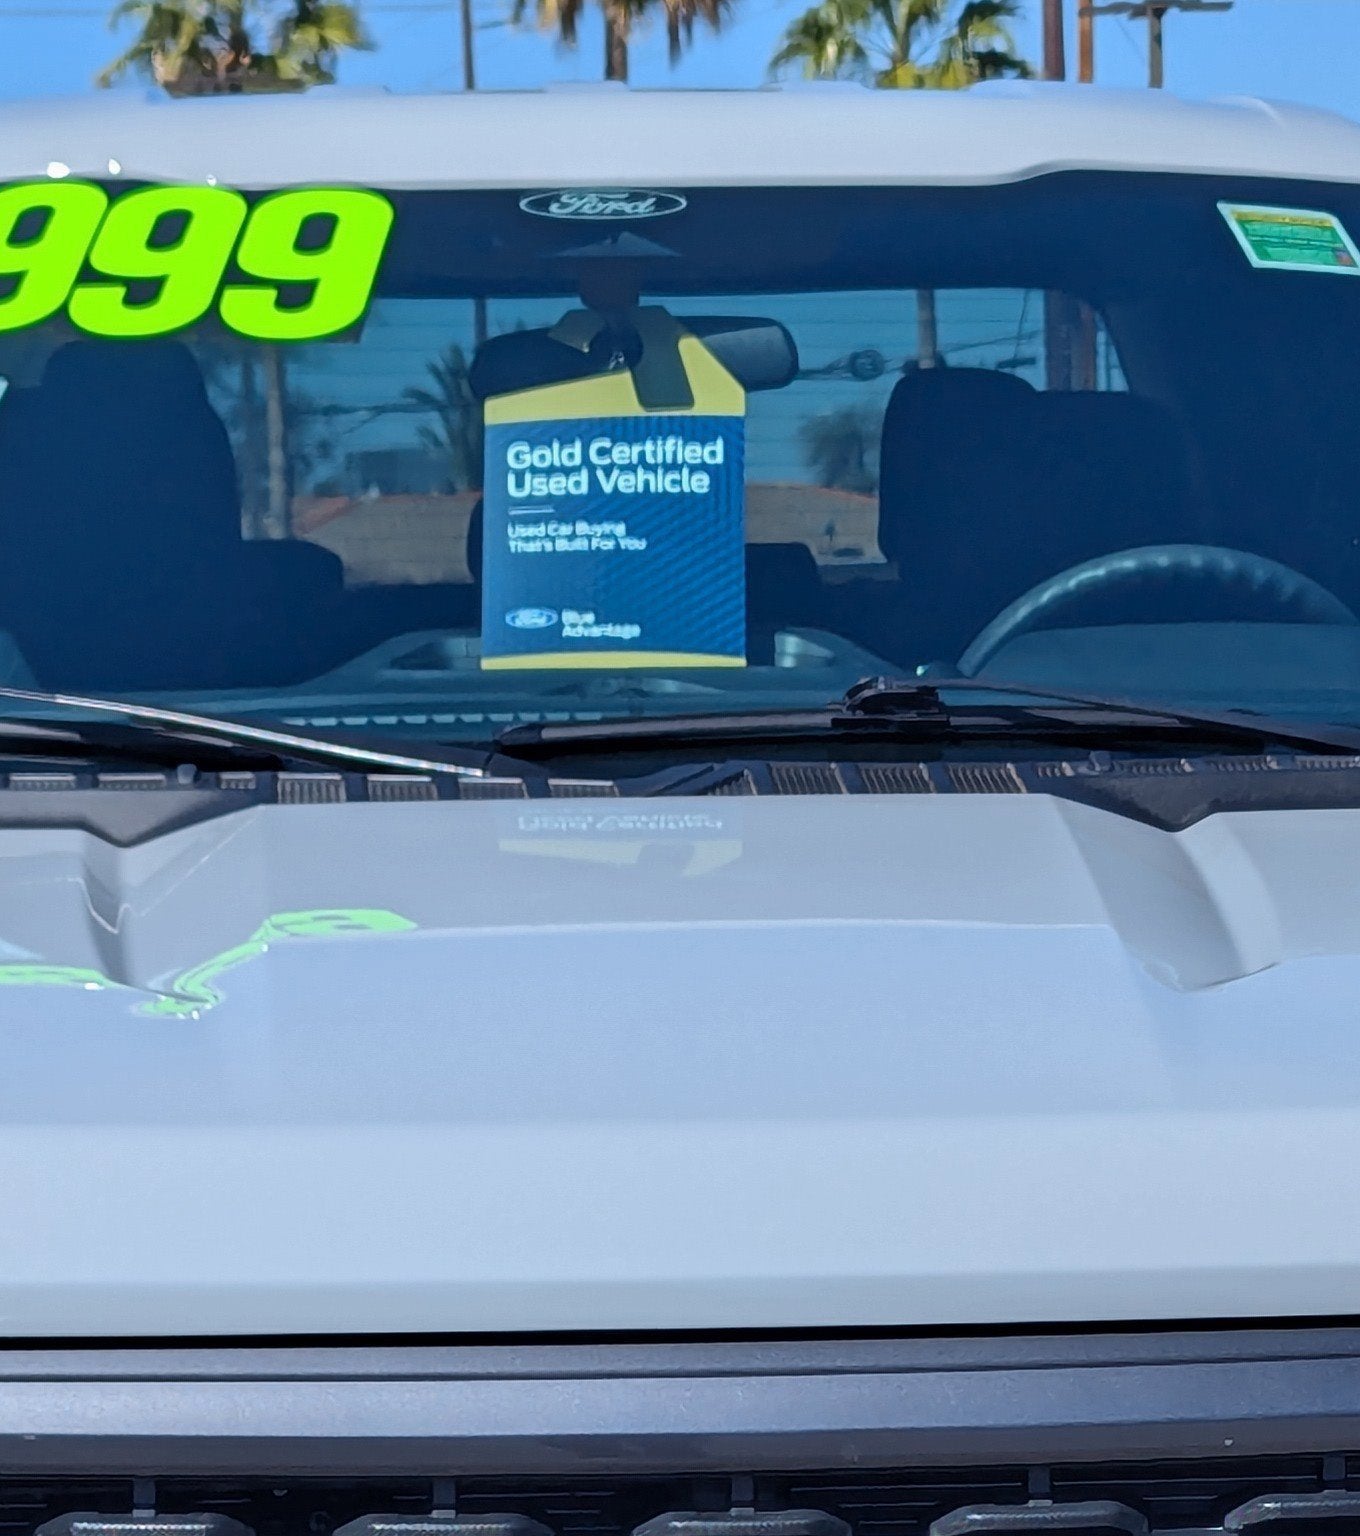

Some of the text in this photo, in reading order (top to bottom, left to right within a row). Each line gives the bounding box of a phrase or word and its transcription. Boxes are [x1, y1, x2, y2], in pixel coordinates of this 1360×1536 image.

[548, 192, 657, 215] Ford
[506, 436, 724, 470] Gold Certified
[506, 465, 711, 498] Used Vehicle
[507, 519, 627, 538] Used Car Buying
[508, 535, 648, 553] That's Built For You
